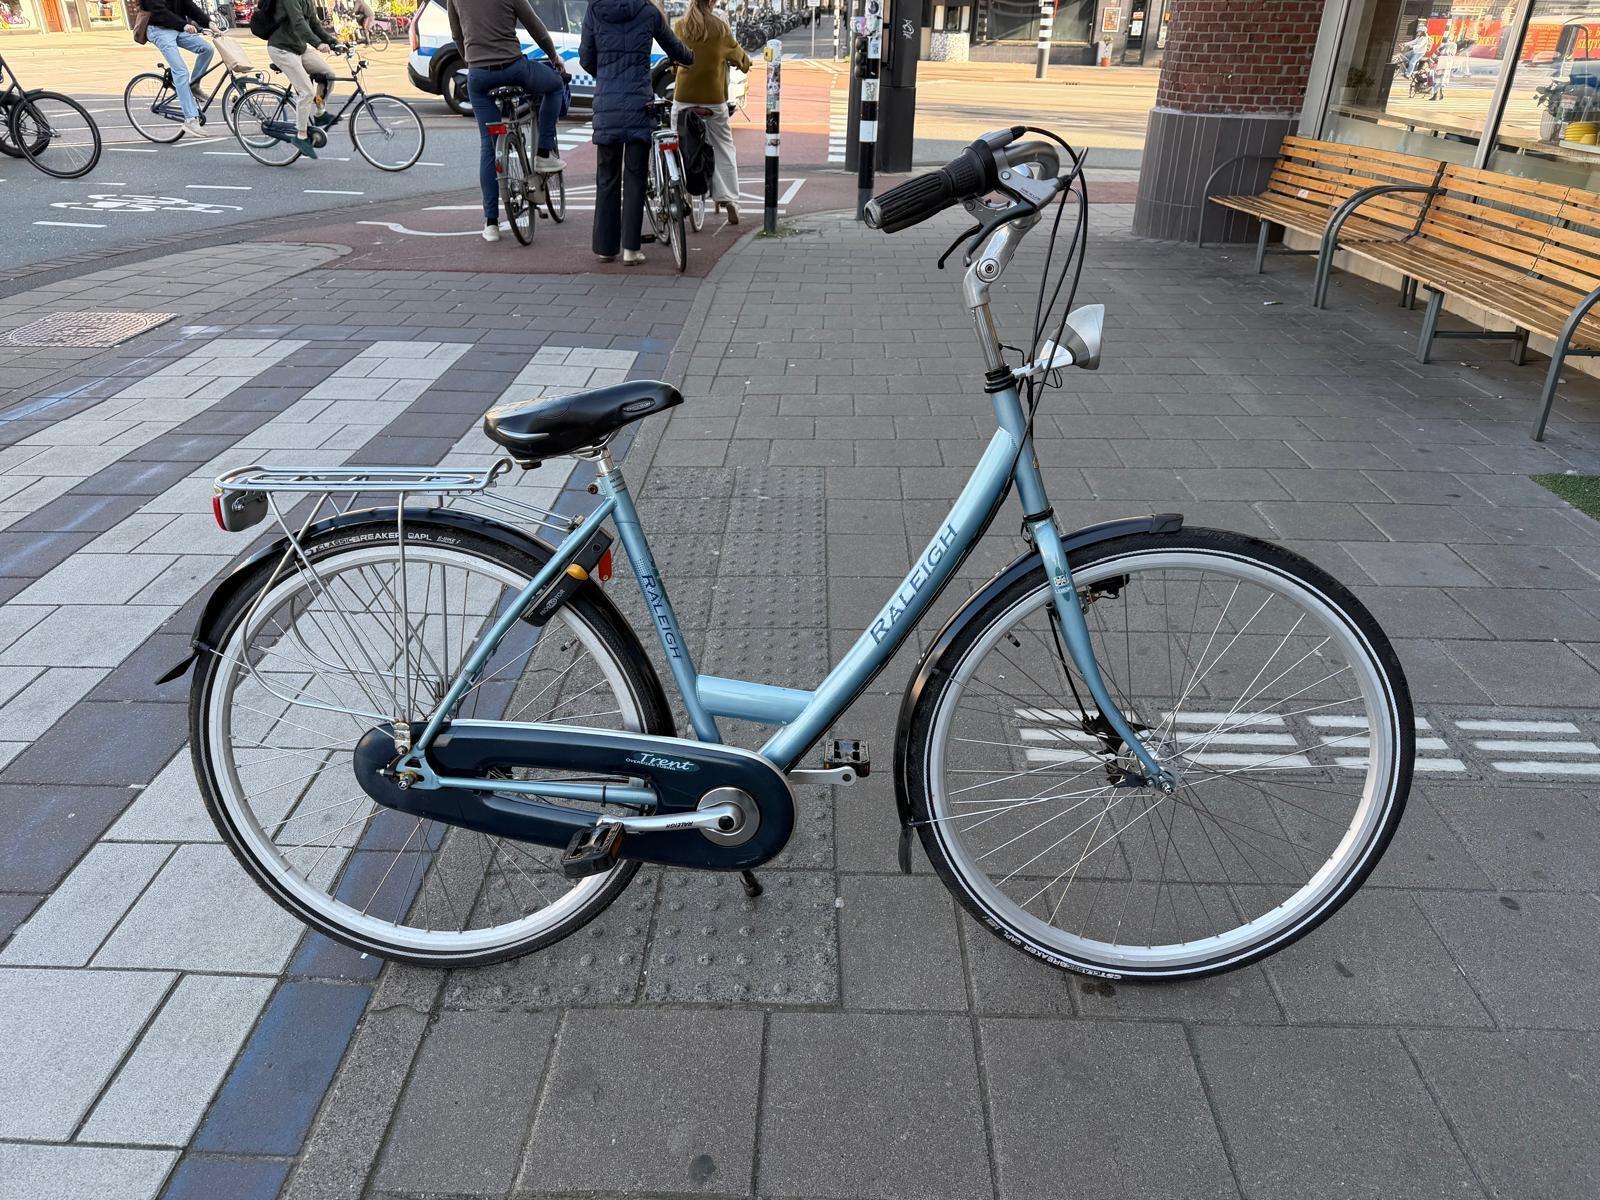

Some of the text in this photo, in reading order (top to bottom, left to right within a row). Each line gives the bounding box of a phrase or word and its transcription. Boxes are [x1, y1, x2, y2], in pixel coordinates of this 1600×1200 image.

[642, 575, 681, 658] RALEIGH
[869, 523, 958, 645] RALEIGH
[640, 753, 694, 770] Trent
